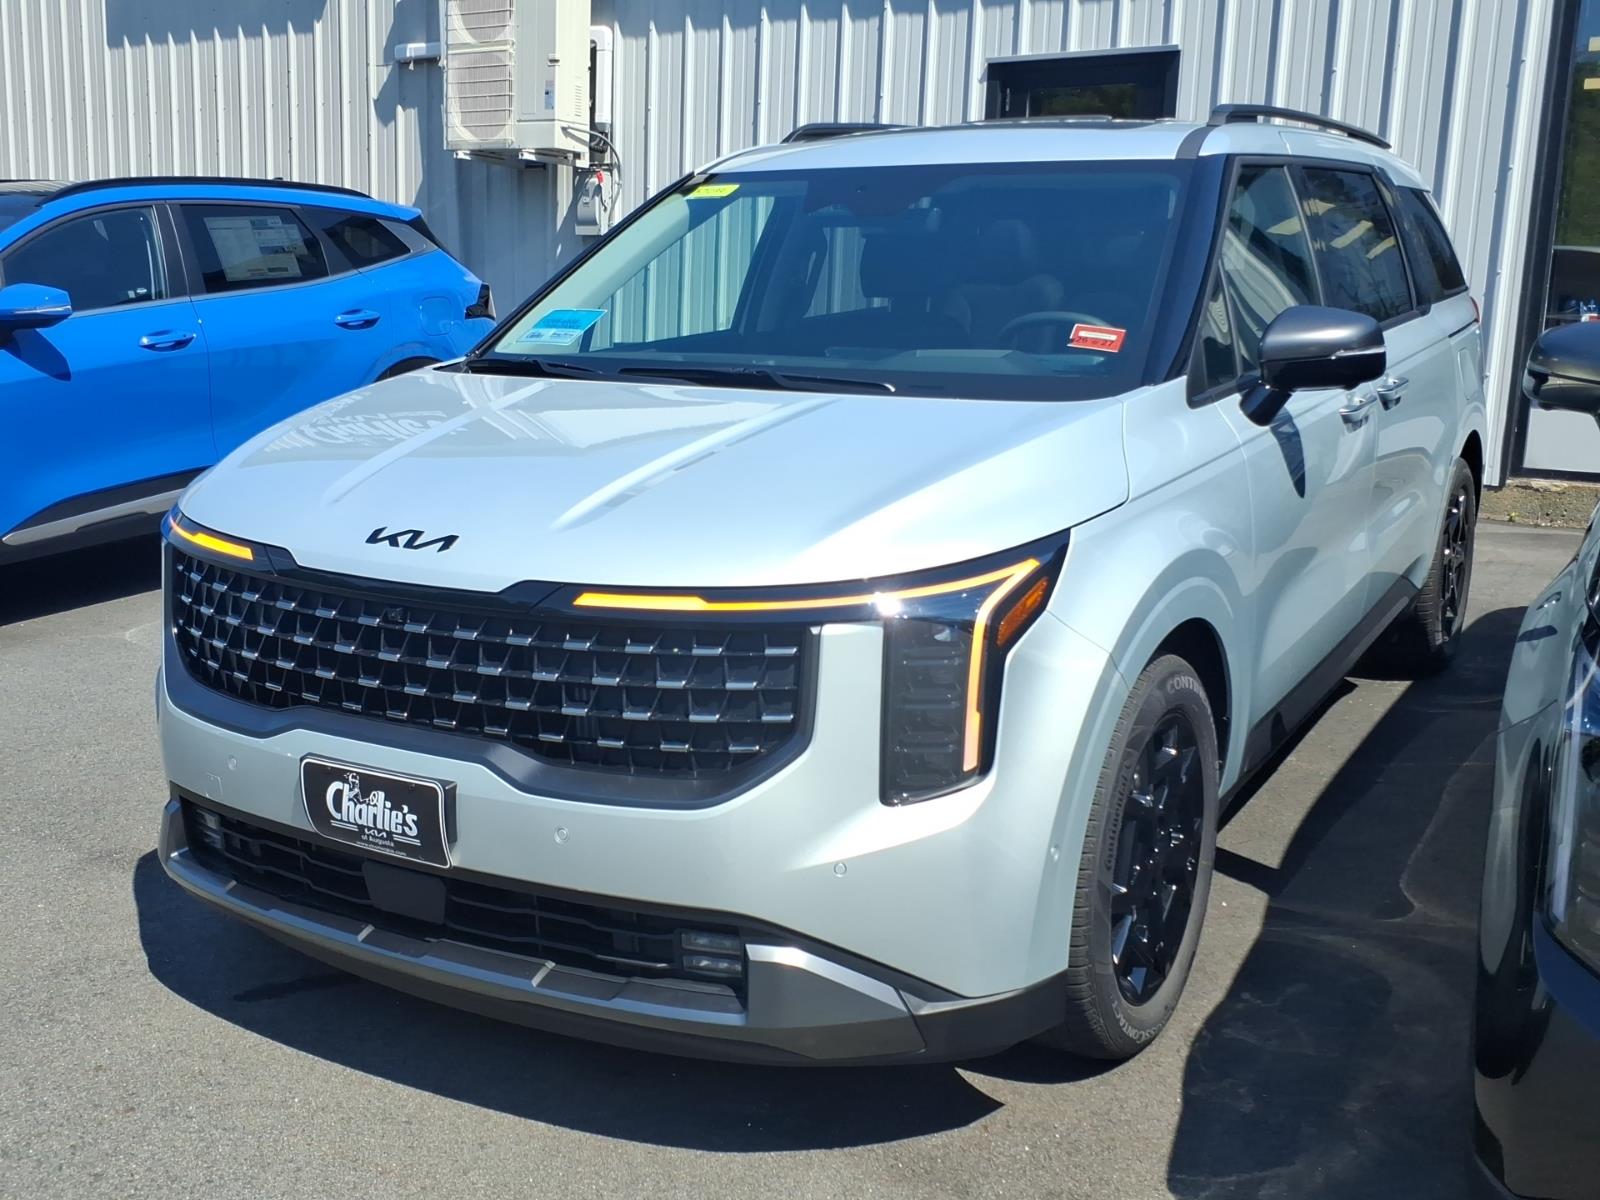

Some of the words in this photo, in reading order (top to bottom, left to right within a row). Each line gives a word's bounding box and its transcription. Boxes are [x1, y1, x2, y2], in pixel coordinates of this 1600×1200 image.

[365, 526, 459, 553] KIA
[325, 780, 418, 837] Charlie's
[364, 828, 387, 838] KIA
